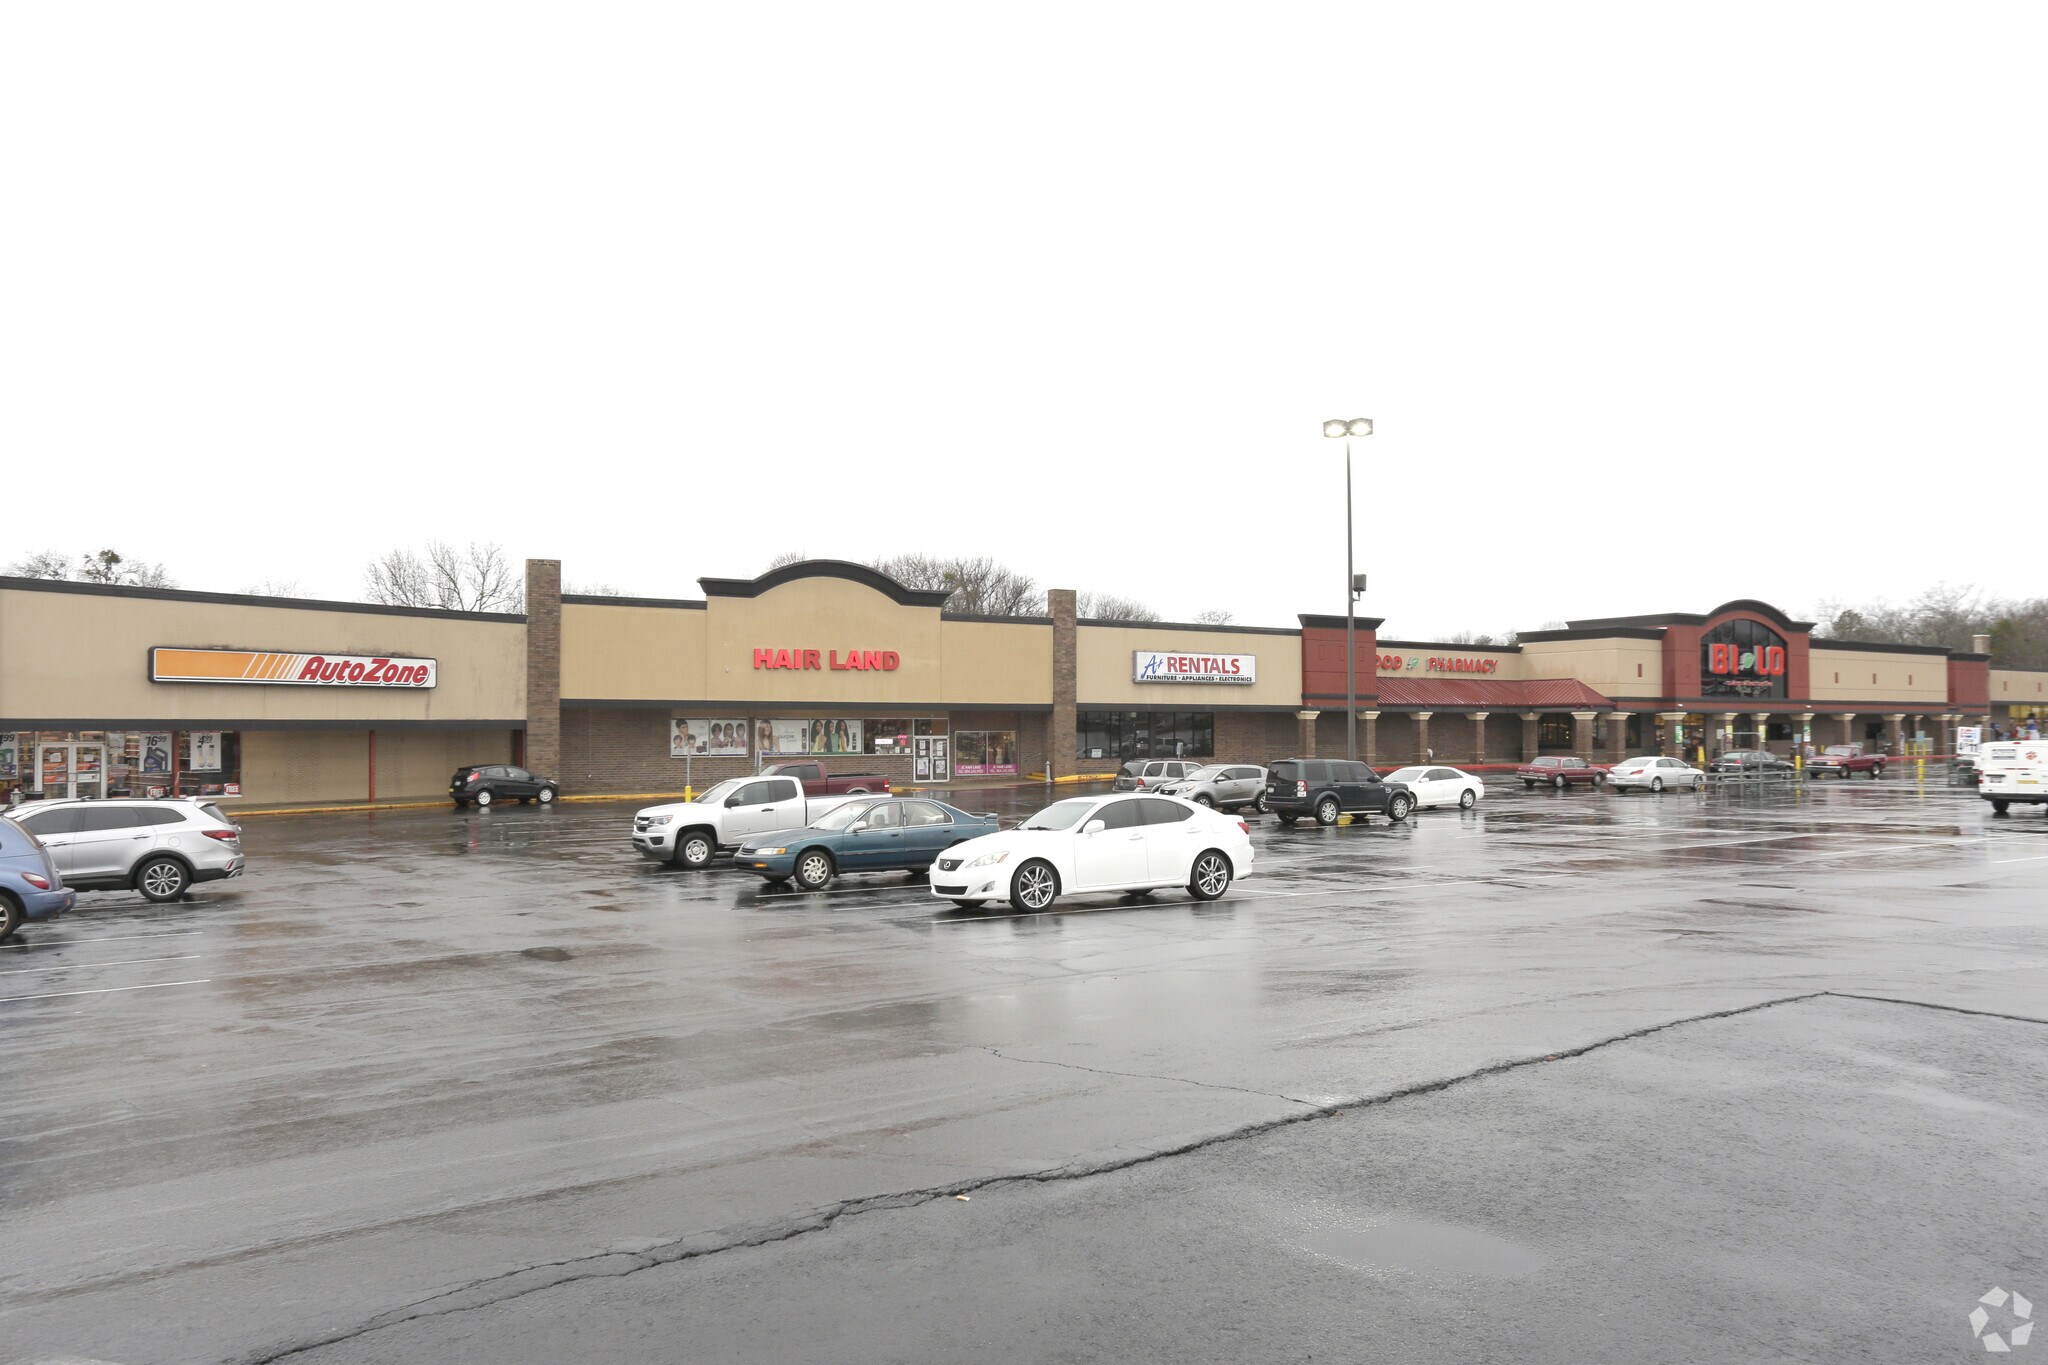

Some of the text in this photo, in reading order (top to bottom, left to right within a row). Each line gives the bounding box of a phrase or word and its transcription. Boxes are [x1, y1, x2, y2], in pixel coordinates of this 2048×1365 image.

[297, 655, 429, 684] AutoZone
[753, 648, 901, 671] HAIR LAND
[1140, 654, 1241, 680] A+ RENTALS
[1376, 654, 1498, 673] OOD PHARMACY
[1709, 643, 1784, 676] BI LO
[226, 785, 239, 793] FREE
